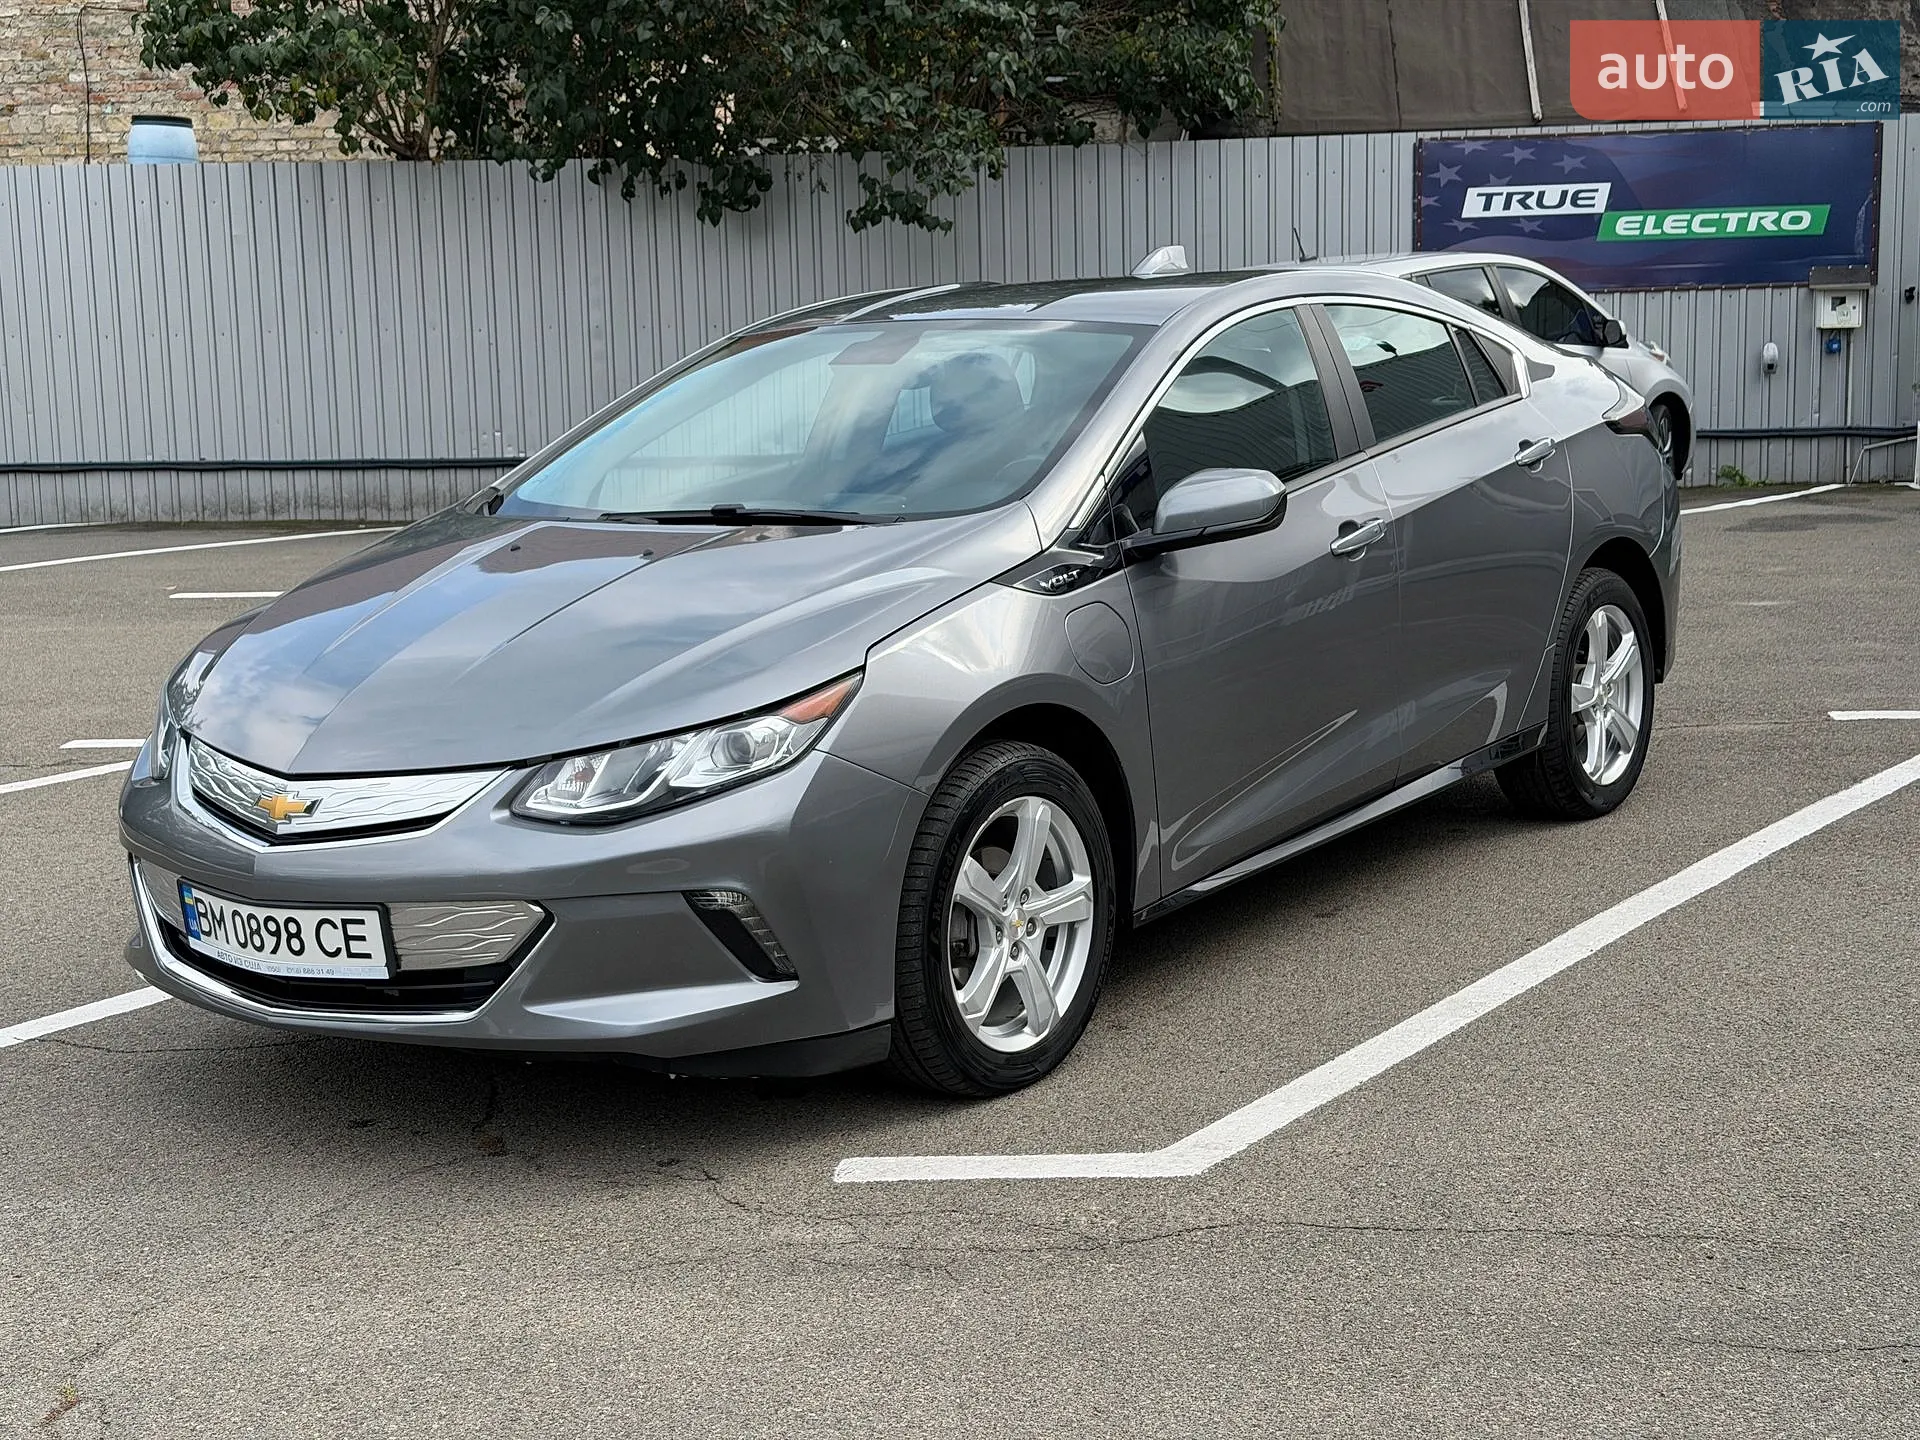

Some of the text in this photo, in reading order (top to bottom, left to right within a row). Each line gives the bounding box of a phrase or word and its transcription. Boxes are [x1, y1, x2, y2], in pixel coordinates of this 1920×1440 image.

[1475, 188, 1600, 213] TRUE
[1614, 210, 1812, 236] ELECTRO
[1036, 569, 1081, 592] VOLT
[193, 896, 373, 960] BM 0898 CE
